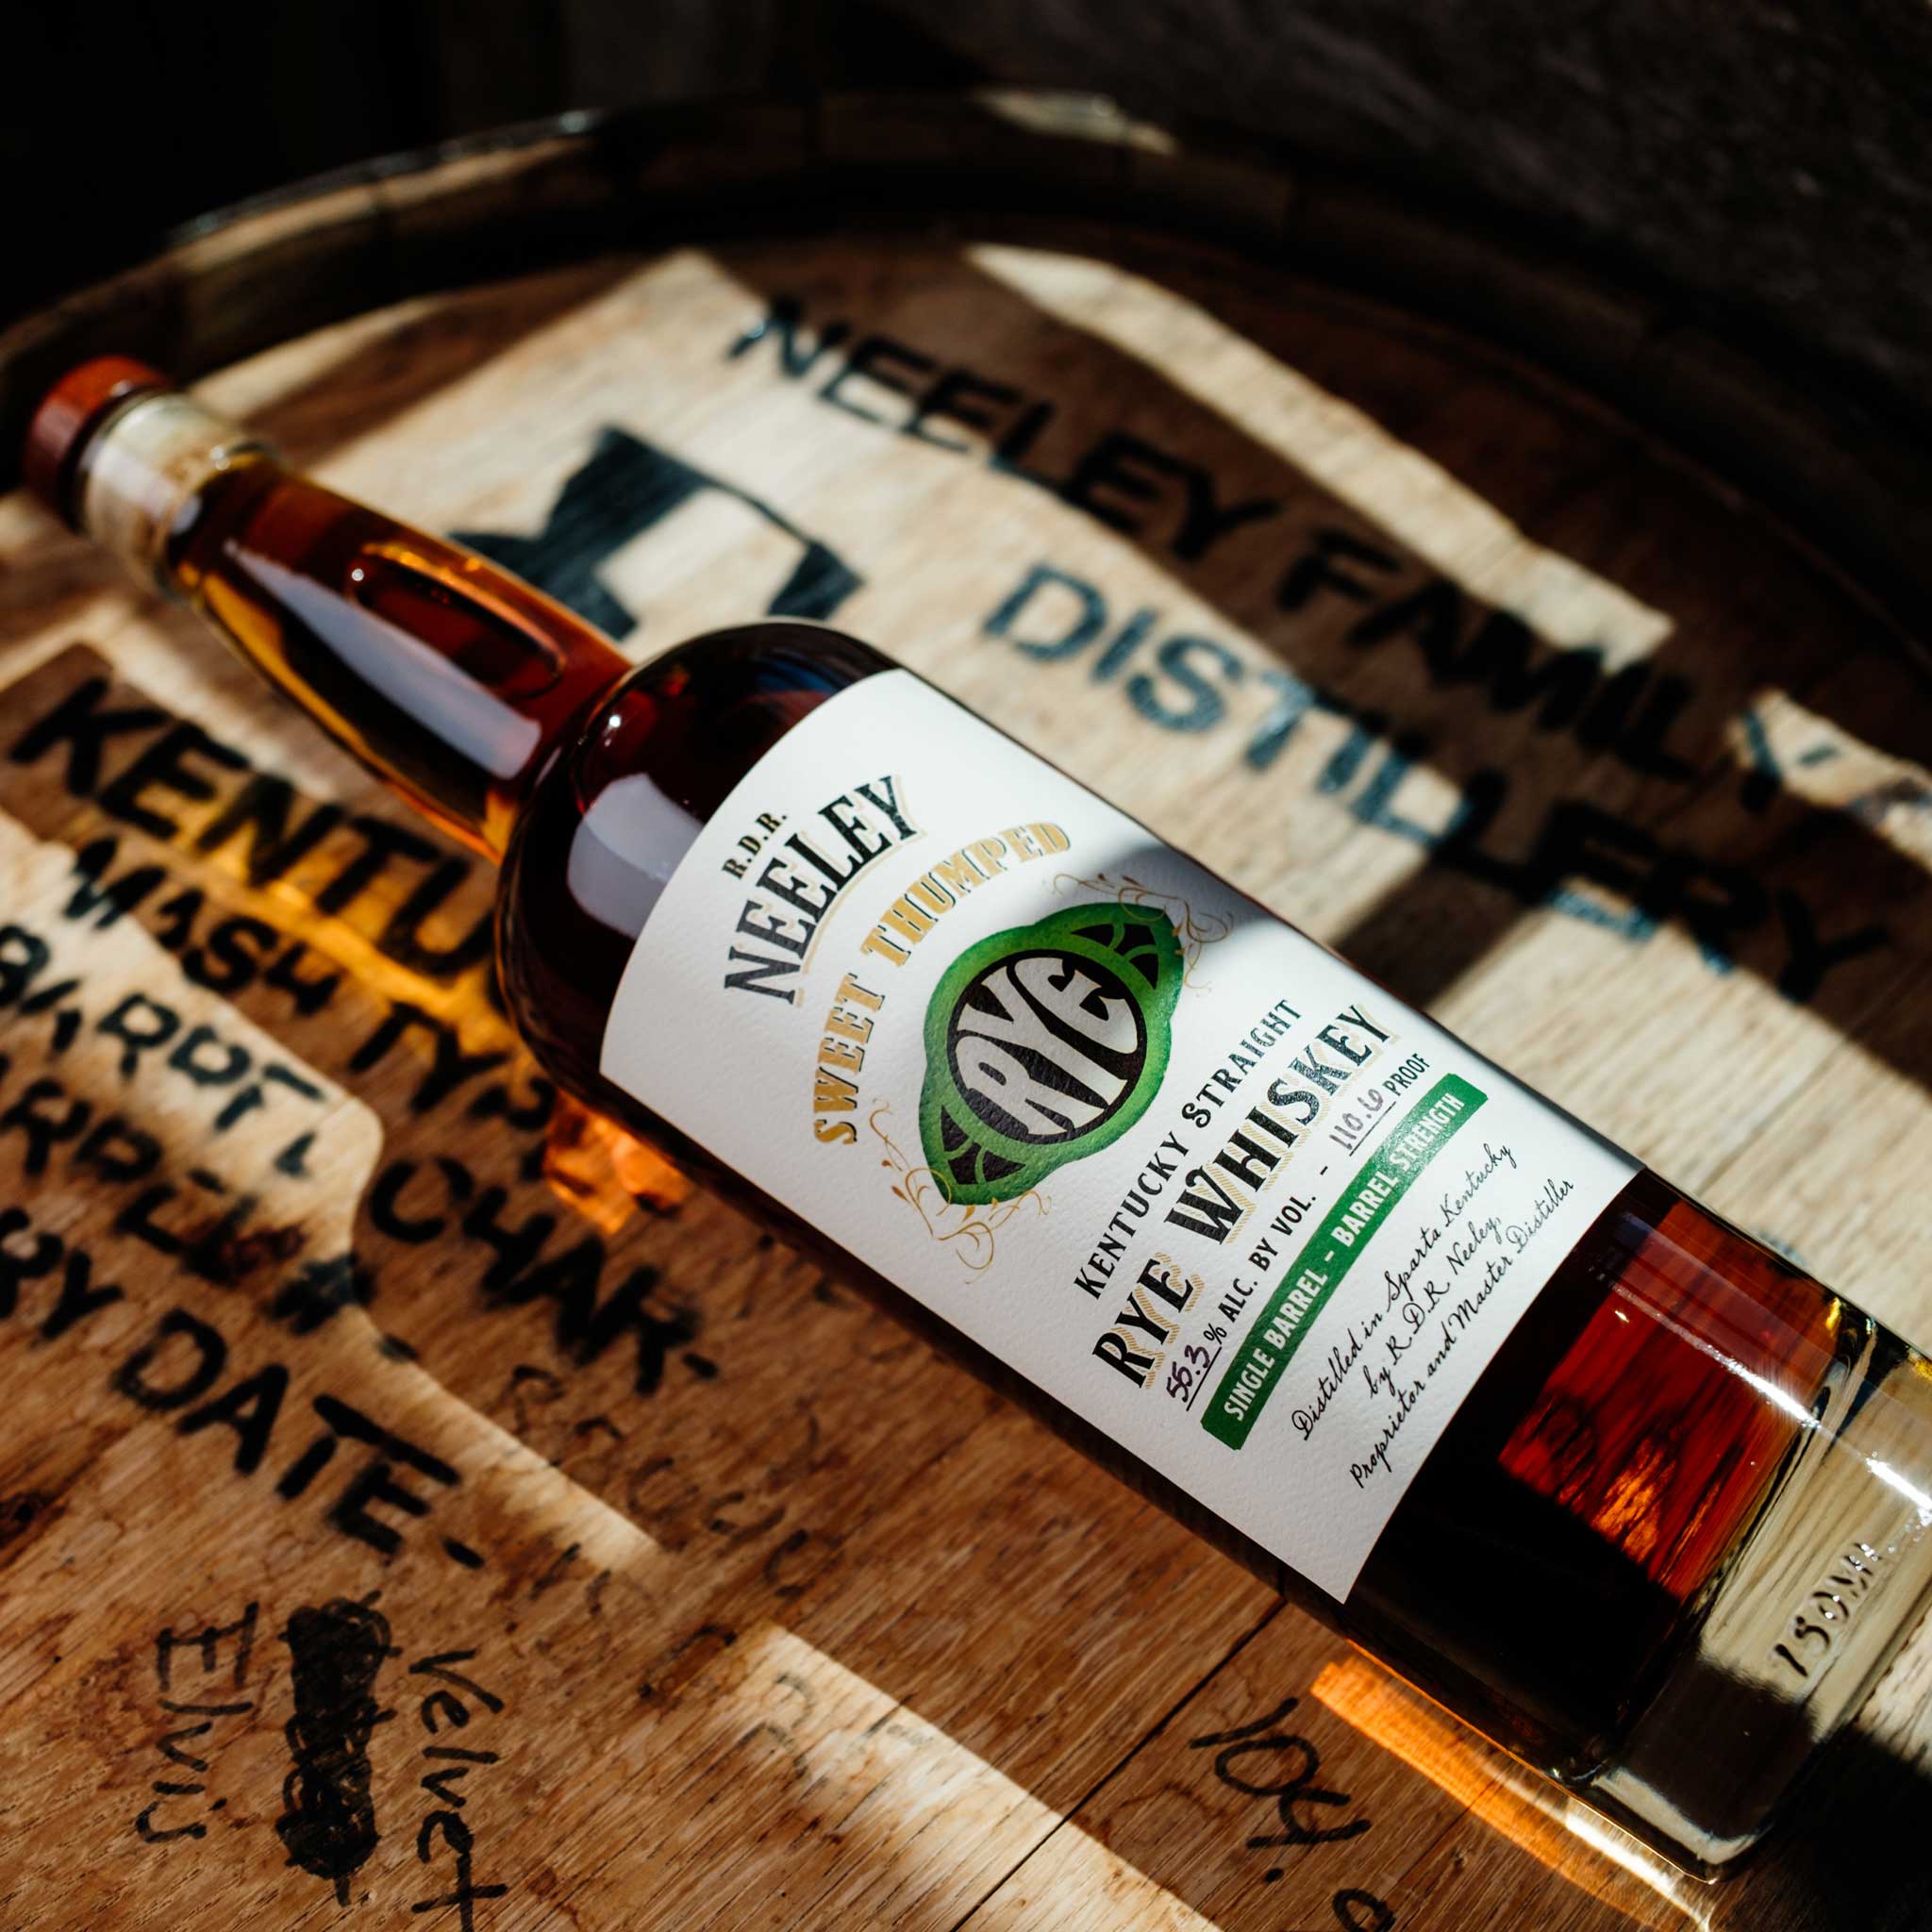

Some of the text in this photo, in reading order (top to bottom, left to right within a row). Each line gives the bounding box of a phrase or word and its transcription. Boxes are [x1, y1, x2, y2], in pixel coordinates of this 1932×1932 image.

[727, 296, 1841, 815] NEELEY FAMILY
[9, 675, 514, 981] KENTU
[61, 835, 348, 1014] MASH
[722, 812, 789, 880] R.D.R.
[724, 774, 925, 1007] NEELEY
[983, 564, 1898, 1004] DISTILLERY
[812, 822, 1072, 1146] SWEET THUMPED
[956, 956, 1139, 1136] RYE
[369, 1155, 704, 1395] CHAR
[1074, 999, 1303, 1300] KENTUCKY STRAIGHT
[1091, 1003, 1396, 1389] RYE WHISKEY
[1218, 1277, 1258, 1323] ALC.
[1248, 1237, 1278, 1272] BY
[1271, 1194, 1317, 1237] VOL.
[1382, 1053, 1430, 1096] PROOF
[1224, 1348, 1275, 1422] SINGLE
[1263, 1268, 1328, 1350] BARREL
[1331, 1171, 1399, 1249] BARREL
[1390, 1092, 1465, 1172] STRENGTH
[1291, 1142, 1518, 1441] Distilled in Sparta Kentucky
[110, 1307, 461, 1555] DATE
[1350, 1177, 1574, 1488] Proprietor and Master Distiller
[1362, 1365, 1392, 1400] by
[135, 1601, 259, 1844] Elvis
[408, 1647, 508, 1932] Velvet
